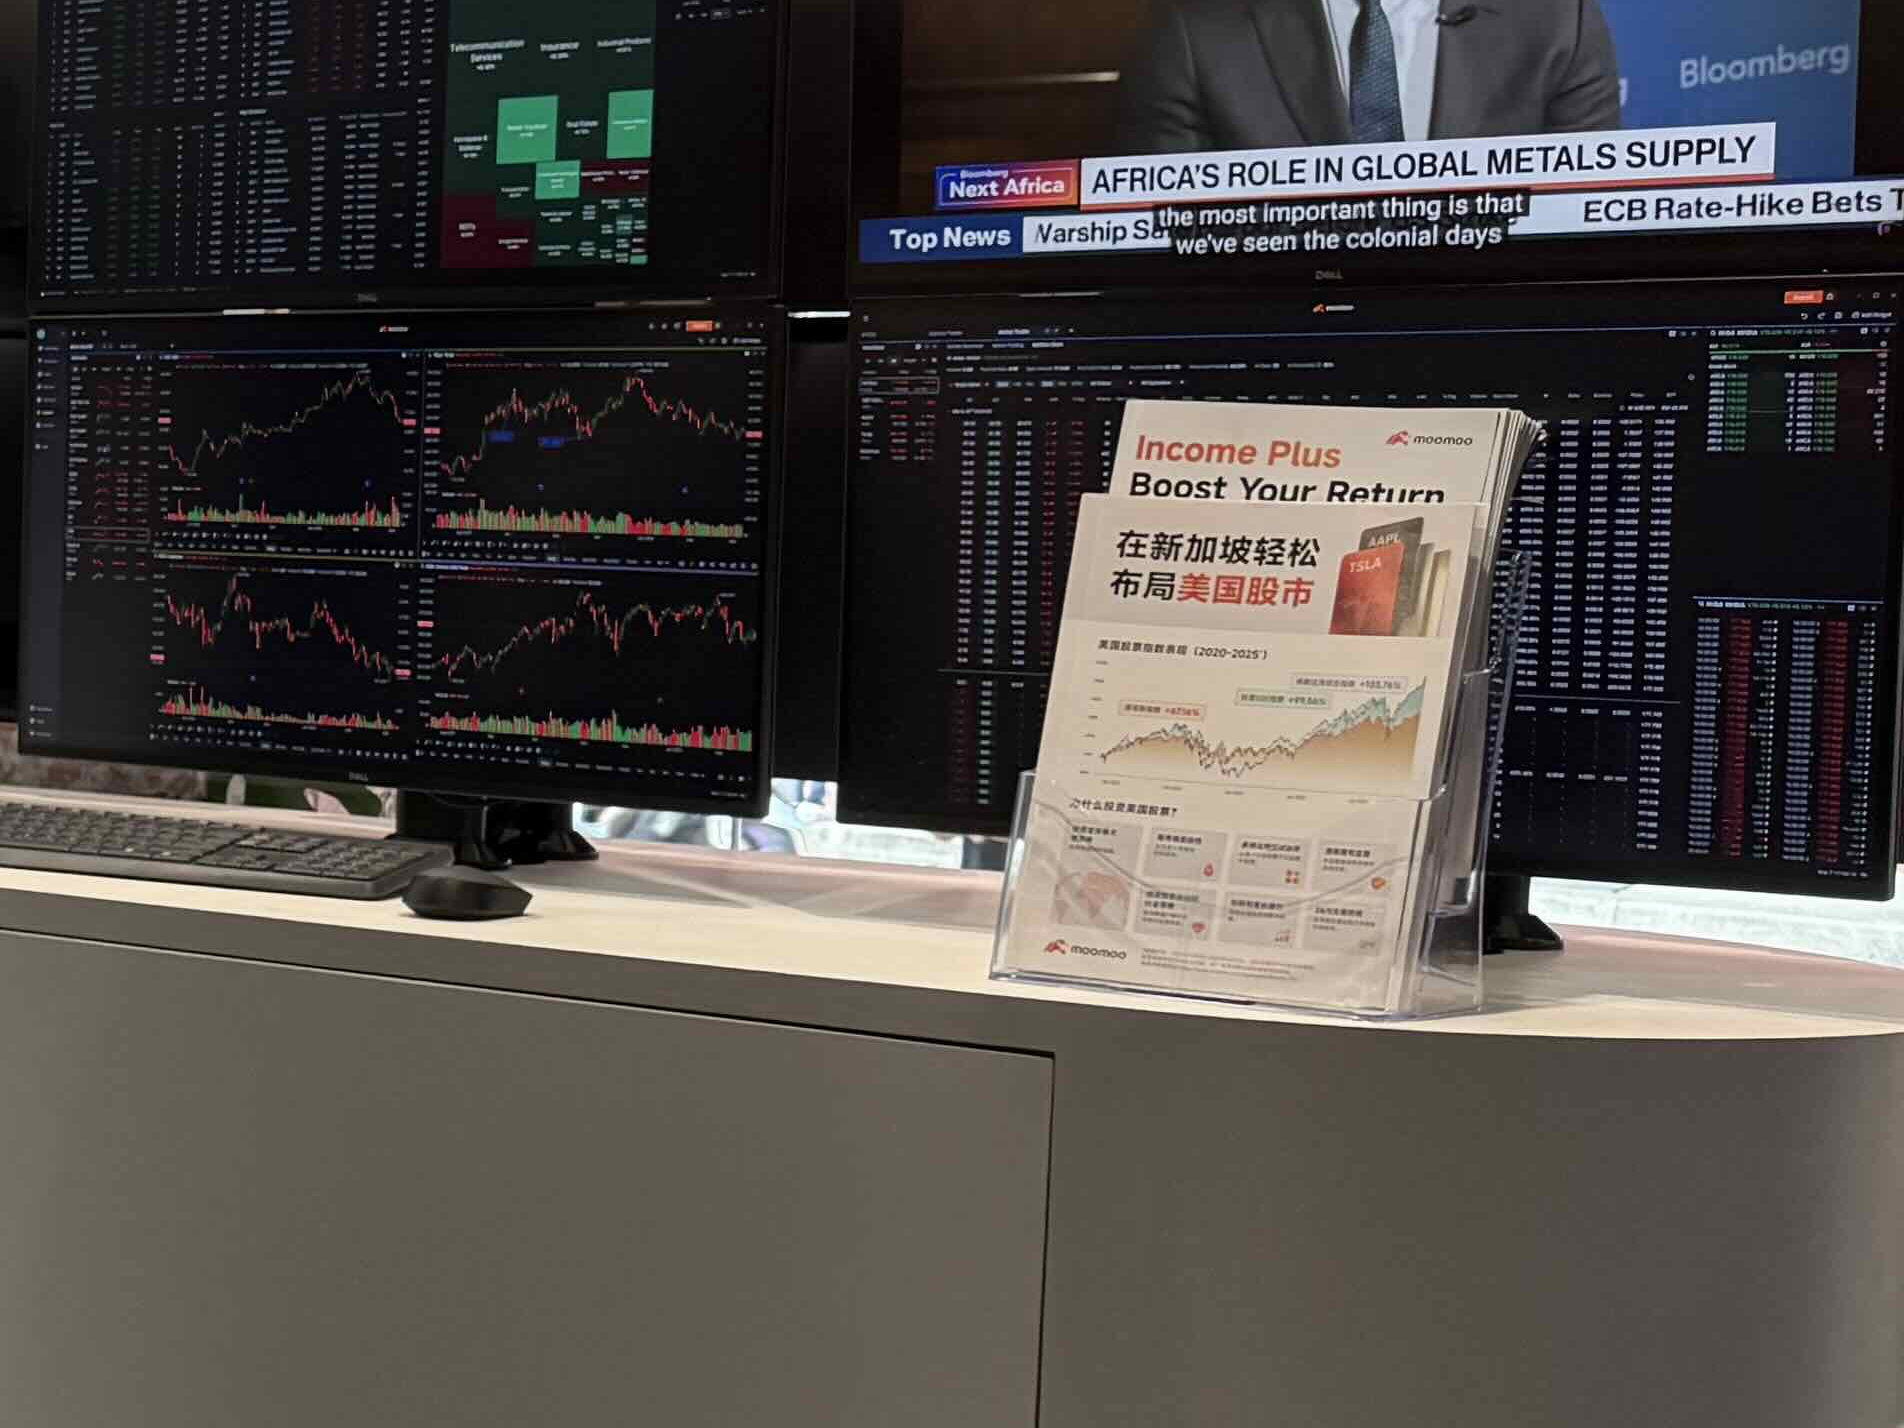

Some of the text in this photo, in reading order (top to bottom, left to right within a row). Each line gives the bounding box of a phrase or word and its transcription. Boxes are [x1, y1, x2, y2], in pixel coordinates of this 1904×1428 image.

[1680, 43, 1850, 89] Bloomberg
[1092, 135, 1757, 194] AFRICA'S ROLE IN GLOBAL METALS SUPPLY
[949, 177, 1065, 199] Next Africa
[1159, 192, 1524, 228] the most important thing is that
[1583, 197, 1647, 223] ECB
[1655, 193, 1804, 221] Rate-Hike
[1812, 190, 1882, 215] Bets
[889, 227, 1011, 253] Top News
[1176, 222, 1502, 256] we've seen the colonial days
[1136, 434, 1473, 468] Income Plus moomoo
[1130, 473, 1445, 503] Boost Your Return
[1116, 529, 1320, 568] 在新加坡轻松
[1348, 556, 1382, 574] TSLA
[1110, 569, 1315, 607] 布局美国股市
[1071, 944, 1127, 960] moomoo
